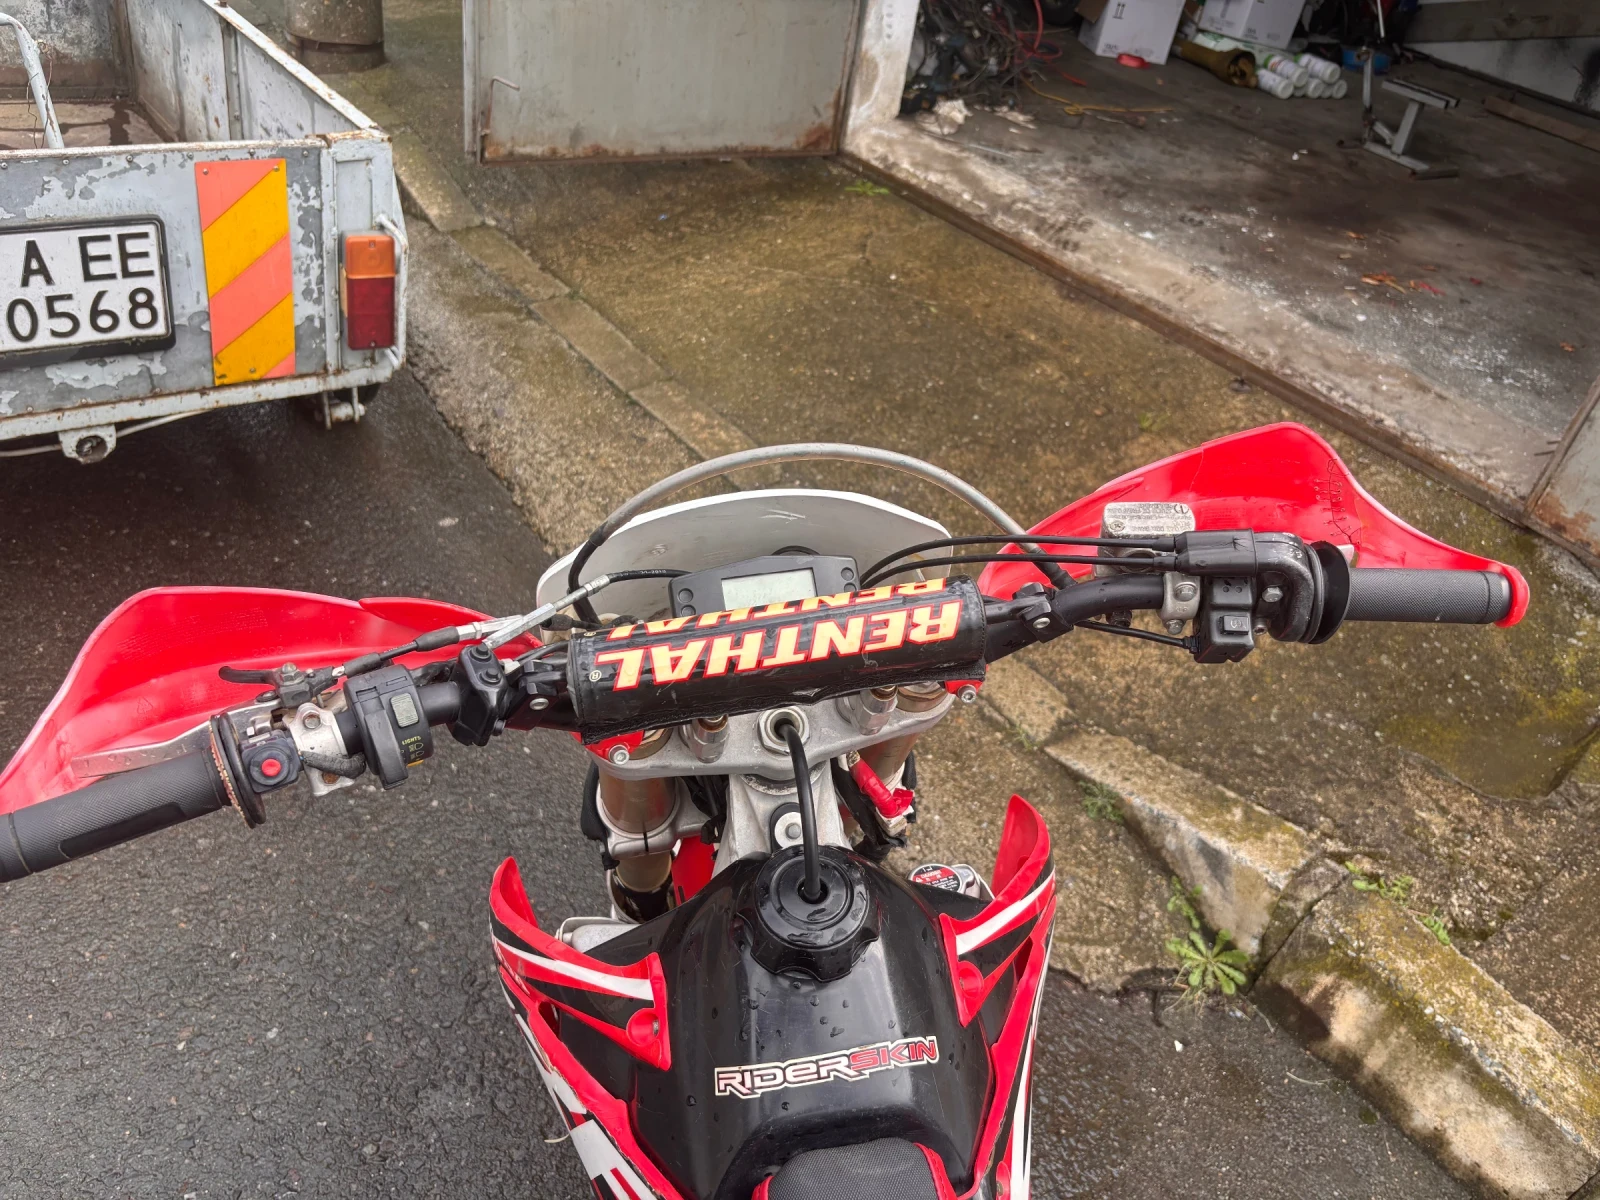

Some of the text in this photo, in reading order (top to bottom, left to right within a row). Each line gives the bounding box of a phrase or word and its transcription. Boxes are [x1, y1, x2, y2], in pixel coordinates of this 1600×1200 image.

[20, 231, 155, 288] A EE
[6, 286, 158, 342] 0568
[594, 600, 963, 692] RENTHAL
[401, 735, 422, 746] LIGHTS
